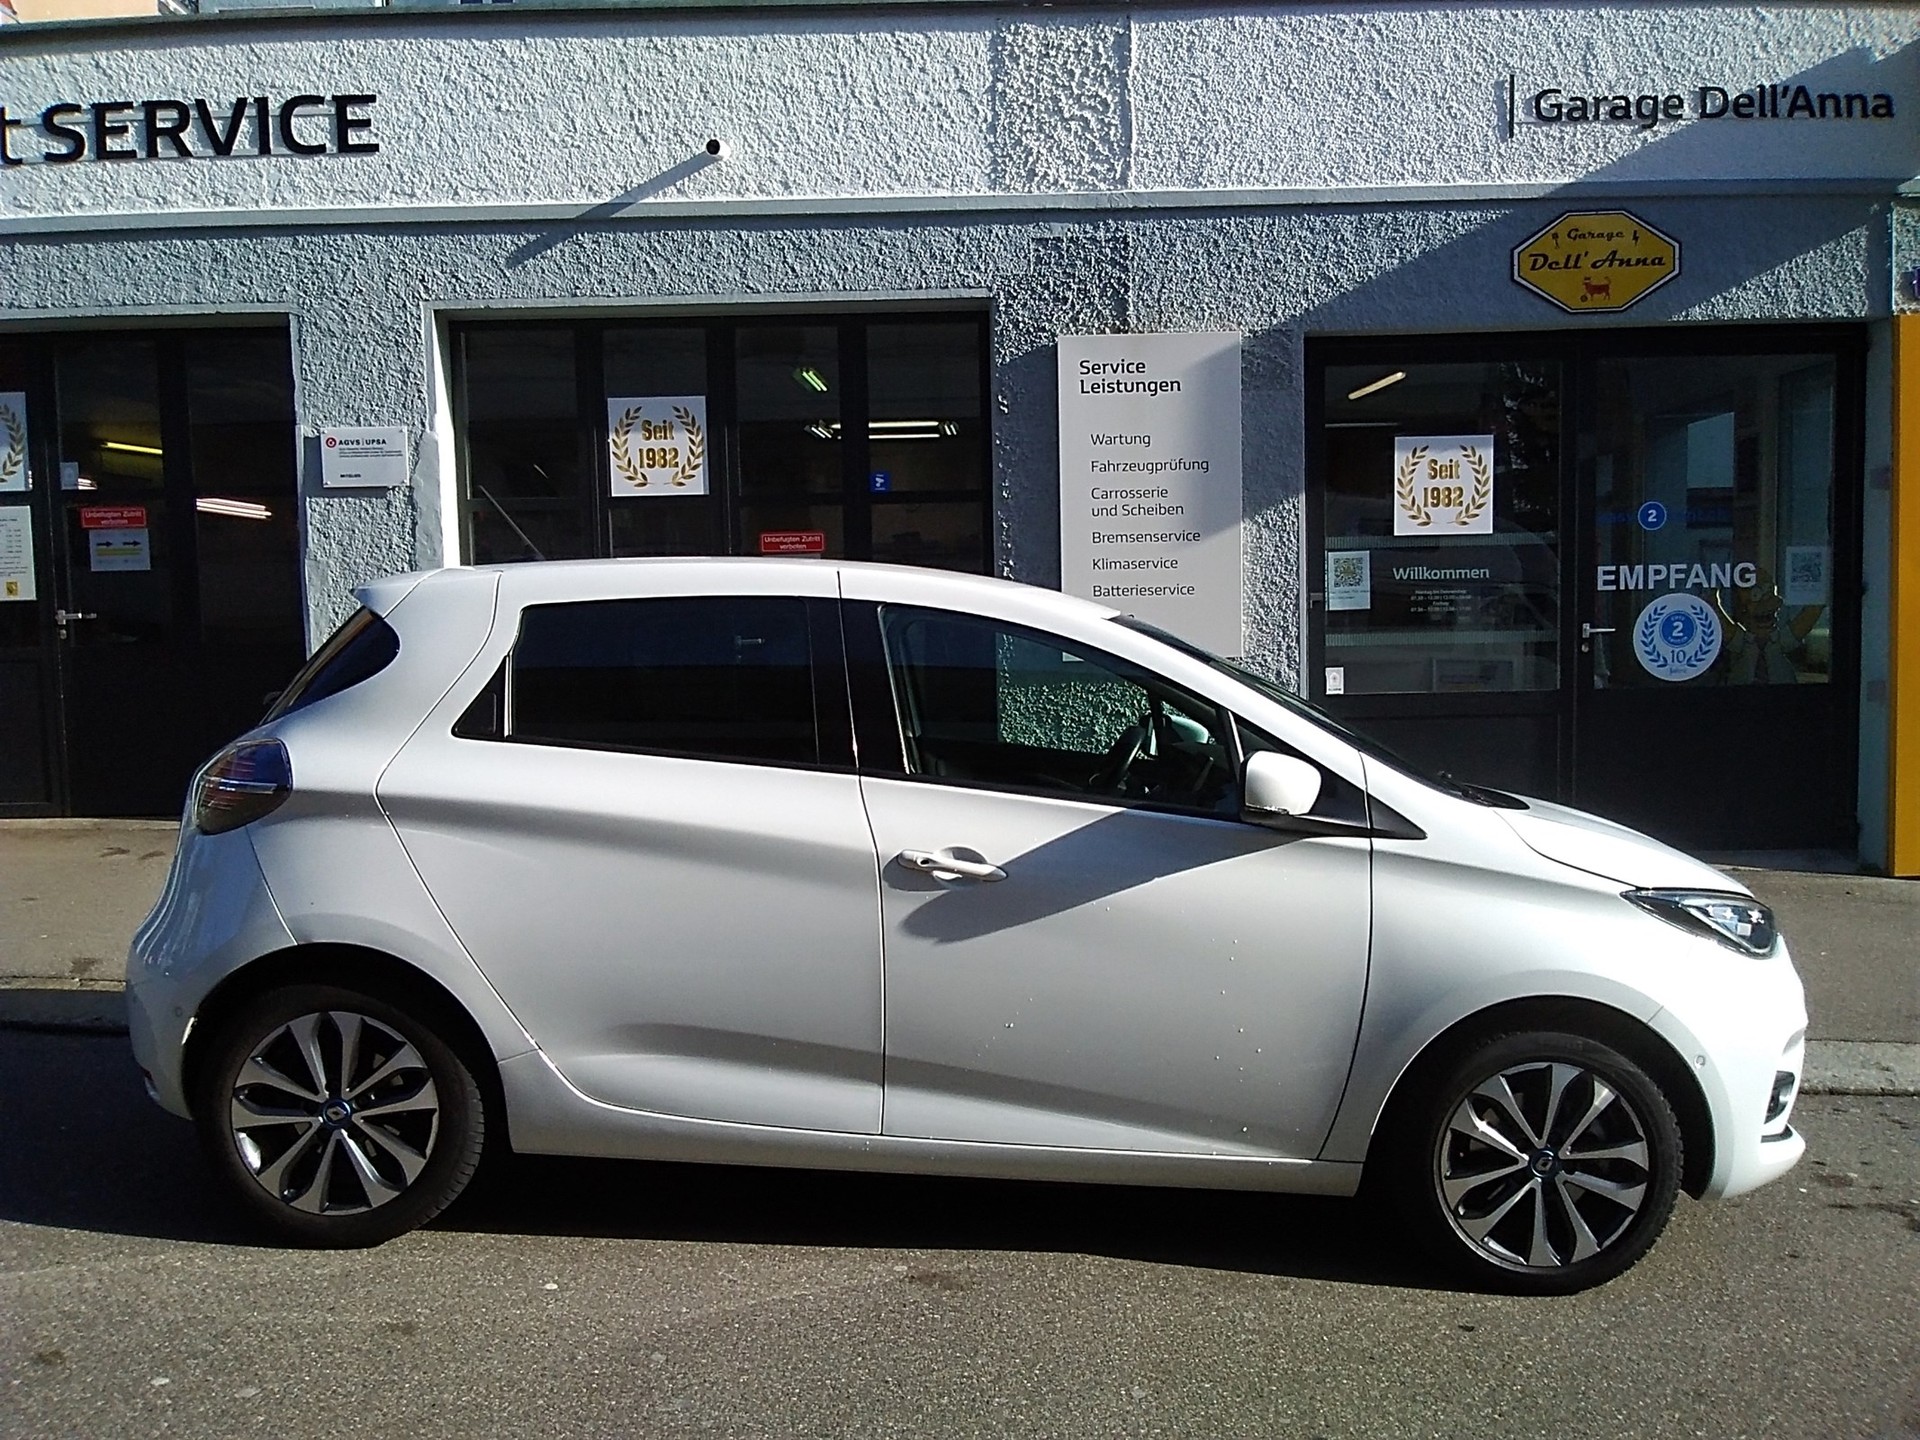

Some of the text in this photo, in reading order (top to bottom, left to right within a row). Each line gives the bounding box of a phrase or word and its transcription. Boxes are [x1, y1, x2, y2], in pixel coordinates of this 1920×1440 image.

[1534, 84, 1895, 128] Garage Dell'Anna
[42, 94, 380, 163] SERVICE
[1566, 228, 1625, 242] Garage
[1528, 250, 1666, 271] Dell' Anna
[1079, 359, 1146, 375] Service
[1080, 378, 1181, 396] Leistungen
[641, 420, 674, 441] Seit
[1090, 433, 1151, 447] Wartung
[638, 448, 679, 469] 1982
[1091, 458, 1209, 474] Fahrzeugprüfung
[1427, 459, 1460, 480] Seit
[1091, 486, 1168, 500] Carrosserie
[1423, 486, 1464, 508] 1982
[1091, 504, 1184, 517] und Scheiben
[1648, 509, 1657, 522] 2
[1092, 530, 1201, 544] Bremsenservice
[1092, 557, 1179, 570] Klimaservice
[1393, 566, 1490, 580] Willkommen
[1597, 562, 1757, 591] EMPFANG
[1093, 584, 1196, 598] Batterieservice
[1672, 621, 1684, 637] 2
[1671, 649, 1686, 664] 10
